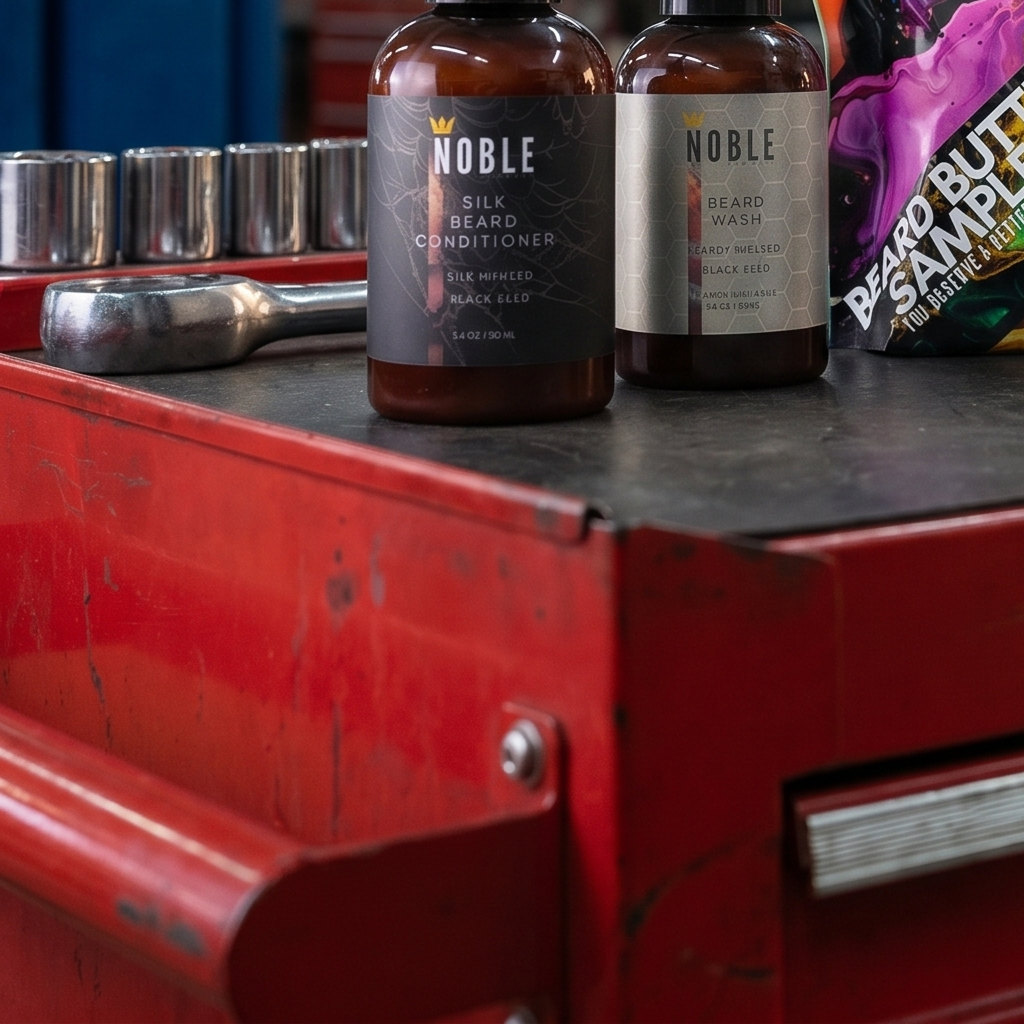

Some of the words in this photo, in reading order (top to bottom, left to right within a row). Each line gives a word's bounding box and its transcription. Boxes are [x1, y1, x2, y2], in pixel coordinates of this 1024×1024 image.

[687, 129, 774, 162] NOBLE
[434, 137, 535, 174] NOBLE
[462, 195, 505, 209] SILK
[708, 196, 764, 209] BEARD
[450, 215, 518, 229] BEARD
[711, 214, 762, 226] WASH
[415, 233, 555, 249] CONDITIONER
[702, 264, 739, 275] BLACK
[842, 194, 934, 331] BEARD
[447, 271, 475, 282] SILK
[902, 303, 931, 332] YOU
